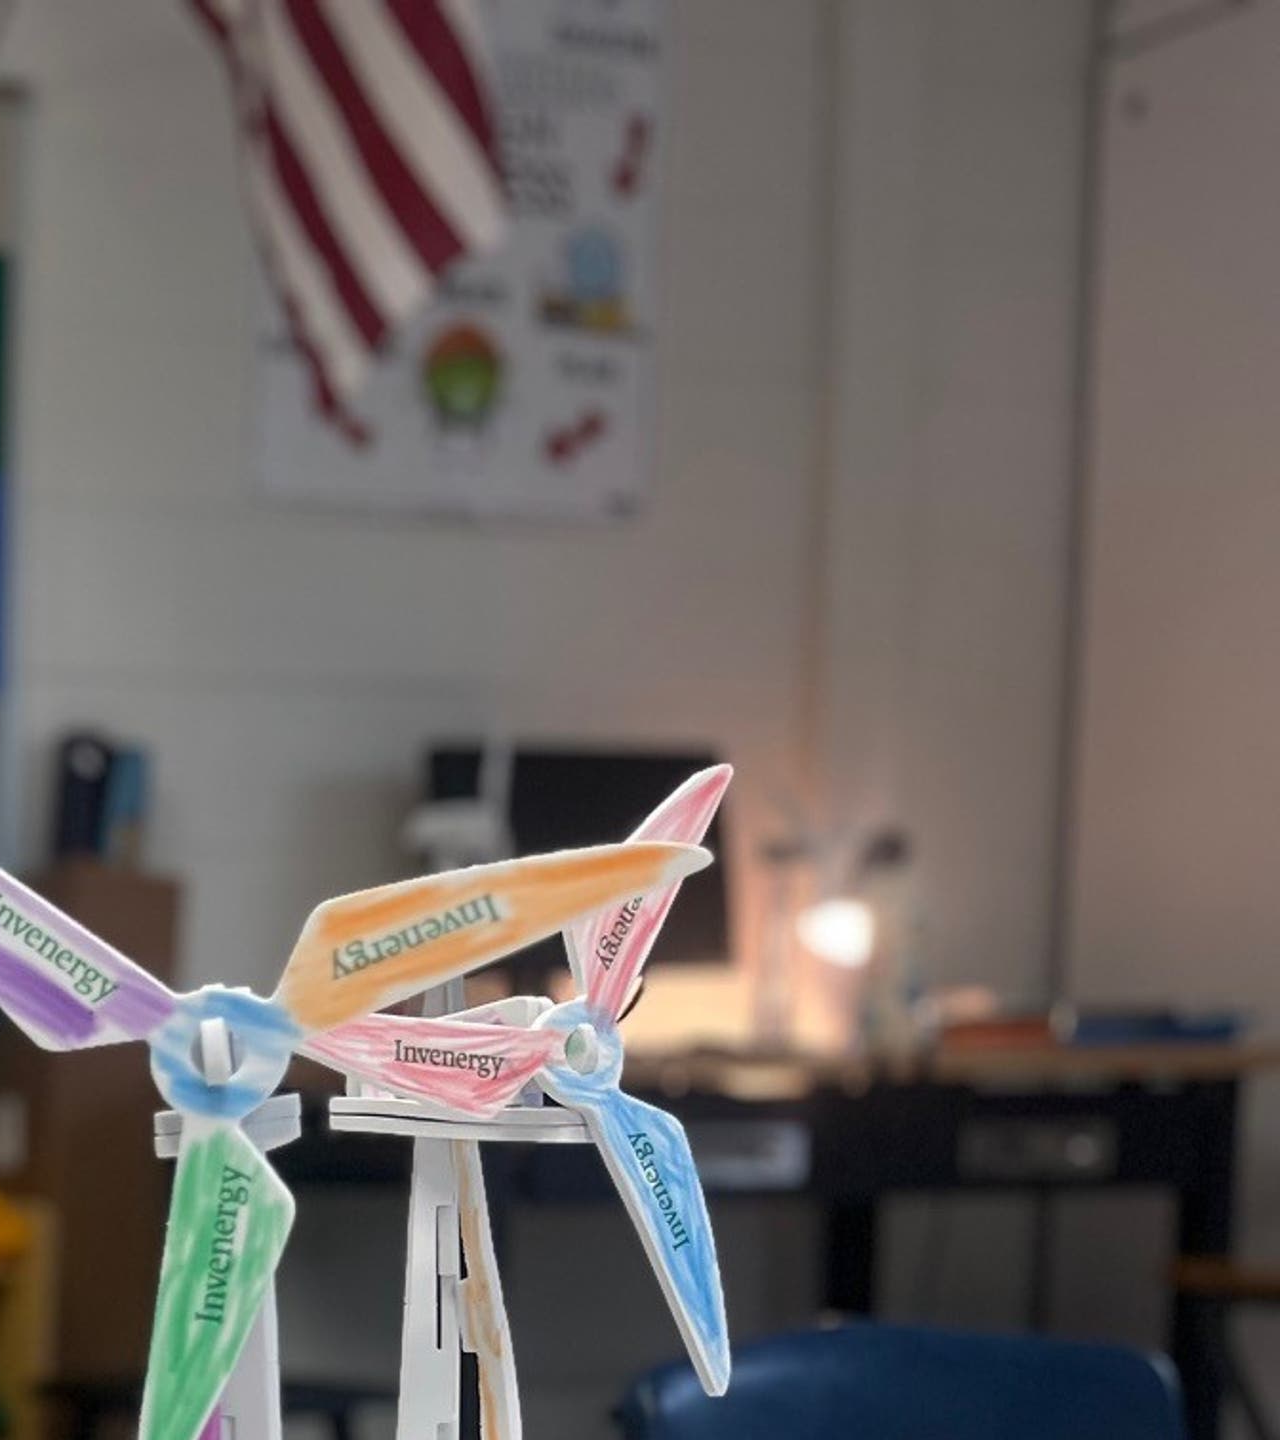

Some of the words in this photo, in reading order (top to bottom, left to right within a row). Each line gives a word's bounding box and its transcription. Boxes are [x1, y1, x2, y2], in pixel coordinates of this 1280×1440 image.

[333, 894, 501, 980] Invenergy
[595, 896, 643, 971] energy
[394, 1039, 506, 1081] Invenergy
[627, 1132, 690, 1252] Invenergy
[195, 1165, 252, 1325] Invenergy
